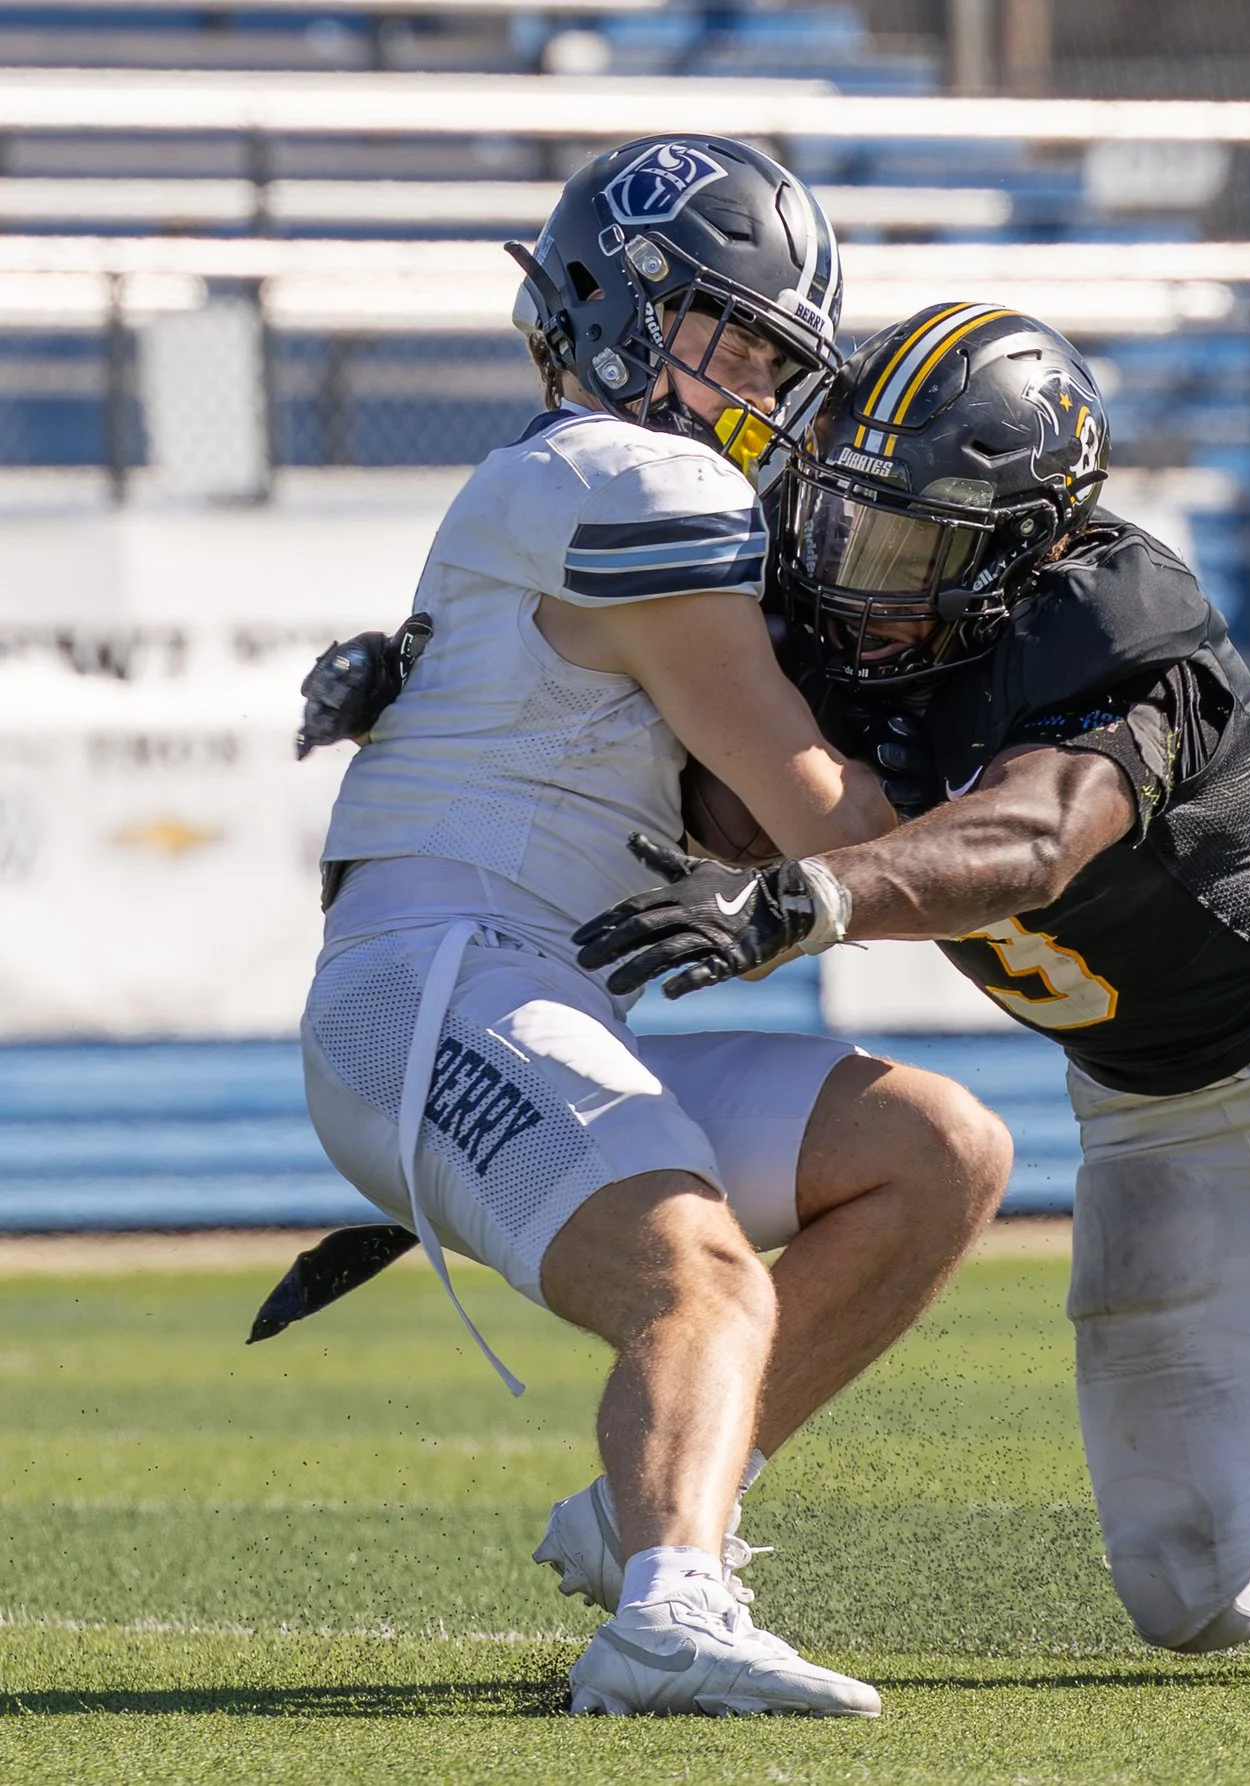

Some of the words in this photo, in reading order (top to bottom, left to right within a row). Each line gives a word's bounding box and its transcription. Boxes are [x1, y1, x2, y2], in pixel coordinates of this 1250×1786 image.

[794, 302, 826, 333] BERRY
[837, 446, 894, 477] PIRATES
[957, 915, 1118, 1031] 3
